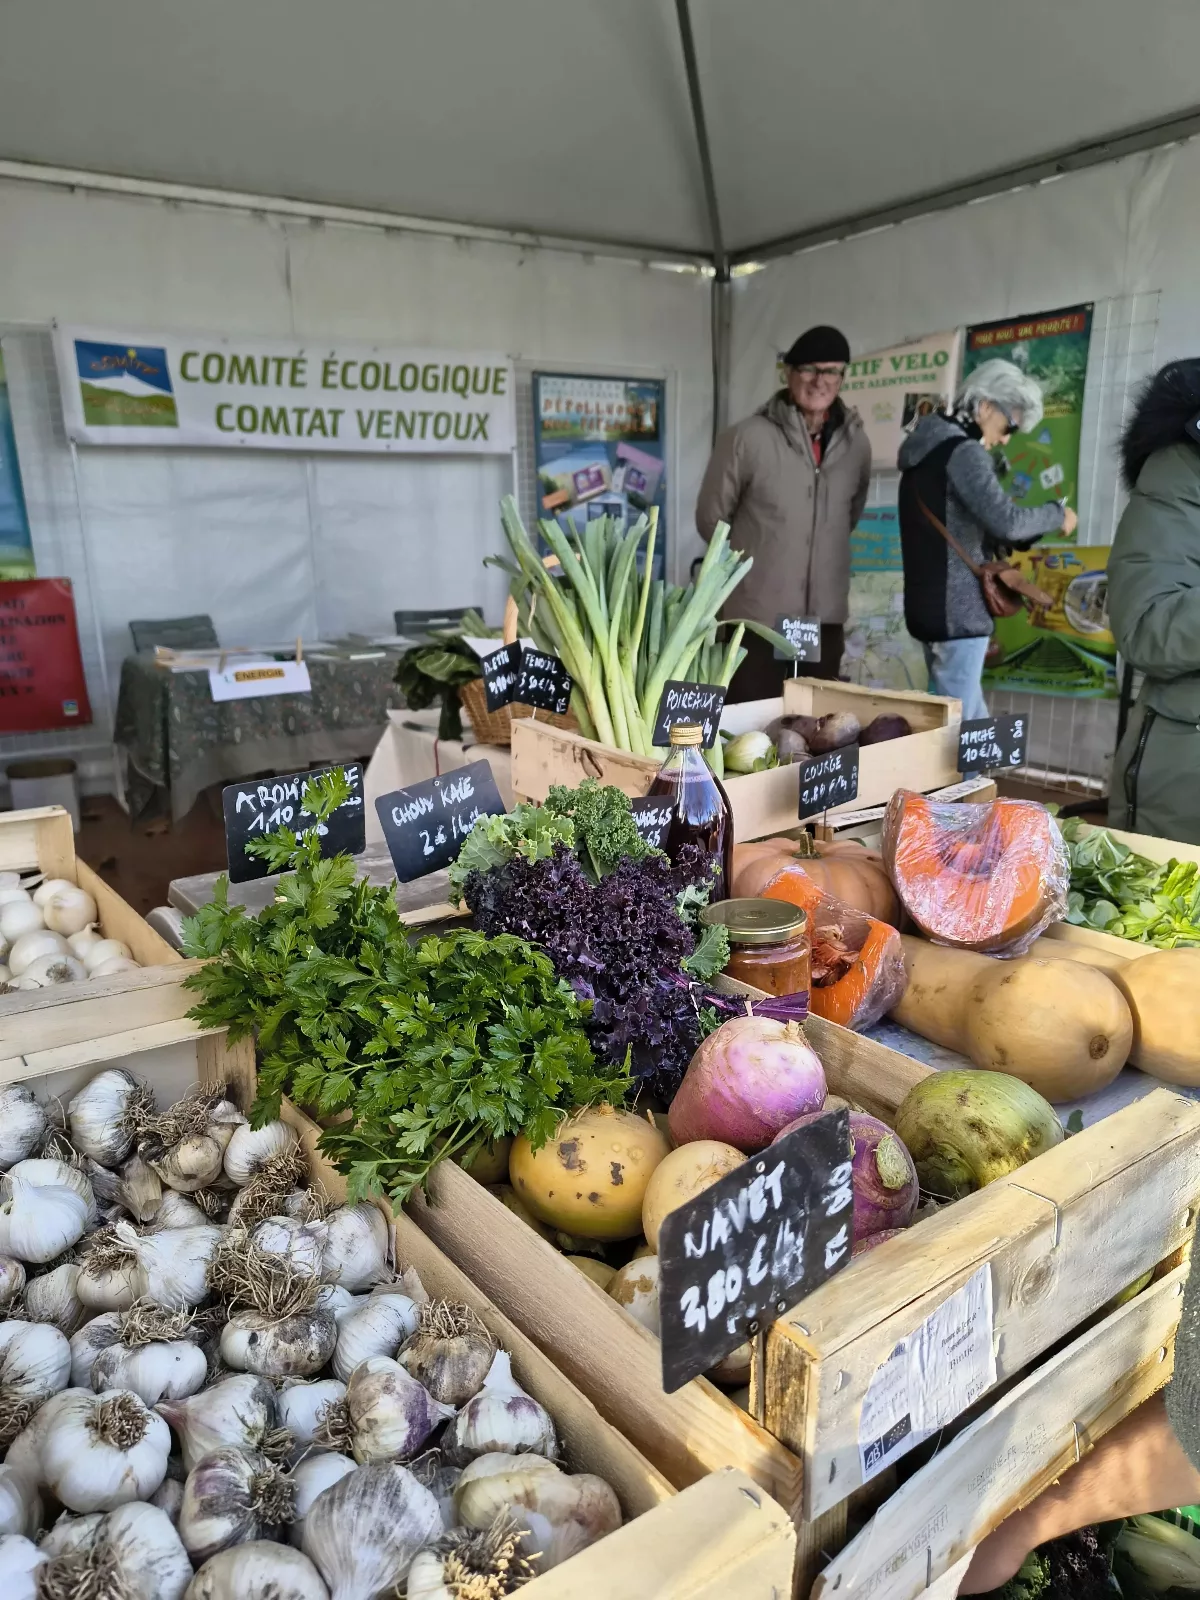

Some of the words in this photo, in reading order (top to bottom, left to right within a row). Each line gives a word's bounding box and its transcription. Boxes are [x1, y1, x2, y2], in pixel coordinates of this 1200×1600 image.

[180, 350, 308, 389] COMITÉ
[322, 351, 509, 400] ÉCOLOGIQUE
[889, 350, 949, 373] VELO
[867, 373, 937, 389] ALENTOURS
[216, 404, 346, 439] COMTAT
[358, 409, 491, 442] VENTOUX
[666, 689, 716, 712] POIREAUX
[804, 754, 842, 782] COURGE
[684, 1161, 787, 1259] NAVET
[949, 1342, 976, 1373] Bintje
[865, 1446, 881, 1470] AB
